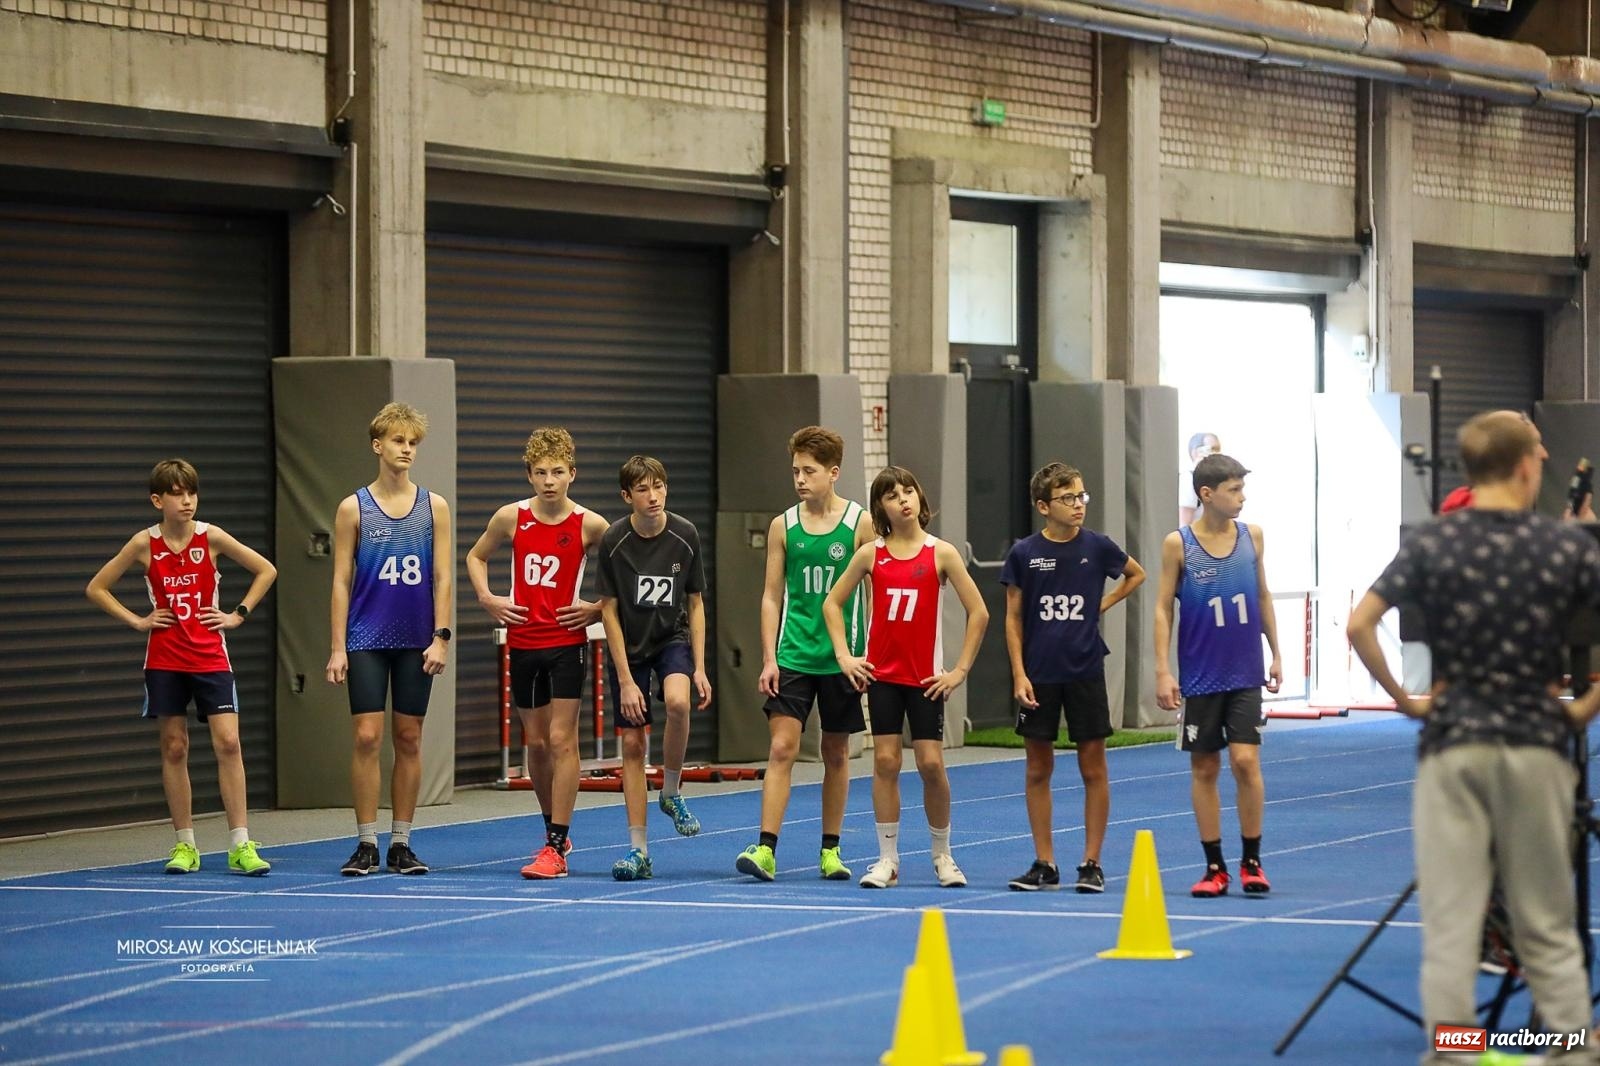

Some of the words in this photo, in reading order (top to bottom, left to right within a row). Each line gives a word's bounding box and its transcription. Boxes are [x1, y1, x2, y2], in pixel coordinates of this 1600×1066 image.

[163, 573, 199, 587] PIAST
[378, 554, 422, 586] 48
[524, 553, 560, 588] 62
[802, 565, 835, 594] 107
[639, 577, 672, 607] 22
[886, 587, 919, 621] 77
[1040, 595, 1085, 621] 332
[1208, 593, 1248, 627] 11
